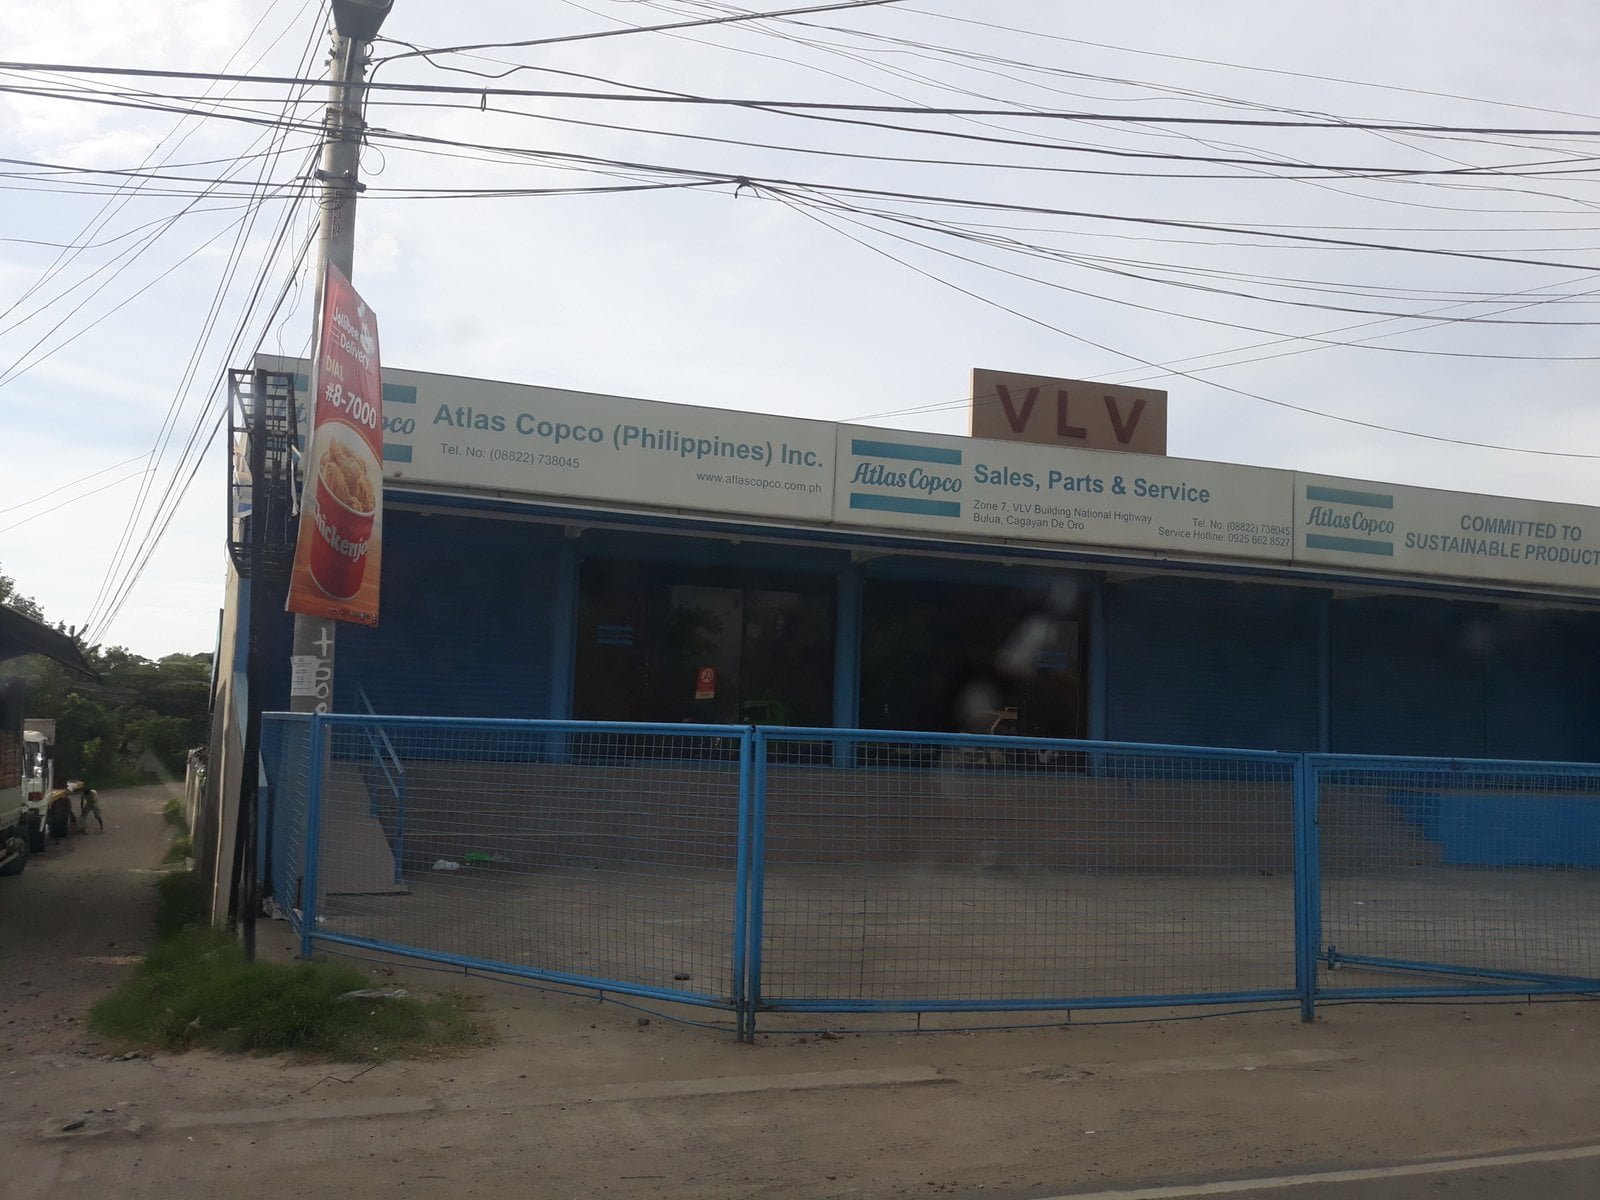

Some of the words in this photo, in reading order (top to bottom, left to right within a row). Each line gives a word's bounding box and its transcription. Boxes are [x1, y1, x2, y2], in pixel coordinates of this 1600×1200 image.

[340, 333, 370, 370] Delivery
[325, 355, 344, 382] DIAL
[325, 381, 377, 430] #8-7000
[433, 403, 506, 432] Atlas
[516, 412, 604, 445] Copco
[613, 424, 773, 467] (Philippines)
[781, 443, 823, 468] Inc.
[440, 442, 462, 456] Tel.
[466, 446, 486, 458] No:
[490, 449, 535, 465] (08822)
[538, 454, 580, 469] 738045
[696, 472, 822, 494] www.atlascopco.com.ph
[974, 464, 1041, 492] Sales,
[1048, 470, 1104, 495] Parts
[1111, 475, 1127, 496] &
[1133, 477, 1211, 503] Service
[973, 500, 998, 511] Zone
[1012, 504, 1032, 514] VLV
[1034, 505, 1072, 519] Building
[1073, 508, 1112, 520] National
[1114, 512, 1152, 524] Highway
[1006, 515, 1049, 529] Cagayan
[1051, 519, 1065, 529] De
[1067, 520, 1085, 530] Oro
[1158, 526, 1191, 539] Service
[1193, 530, 1227, 542] Hotline:
[1228, 533, 1250, 544] 0925
[1251, 535, 1268, 545] 662
[1270, 537, 1291, 547] 8527
[1192, 518, 1208, 529] Tel.
[1210, 520, 1225, 531] No:
[1227, 521, 1259, 534] (08822)
[1261, 524, 1291, 536] 738045
[1460, 514, 1557, 540] COMMITTED
[1562, 525, 1583, 542] TO
[1404, 531, 1521, 559] SUSTAINABLE
